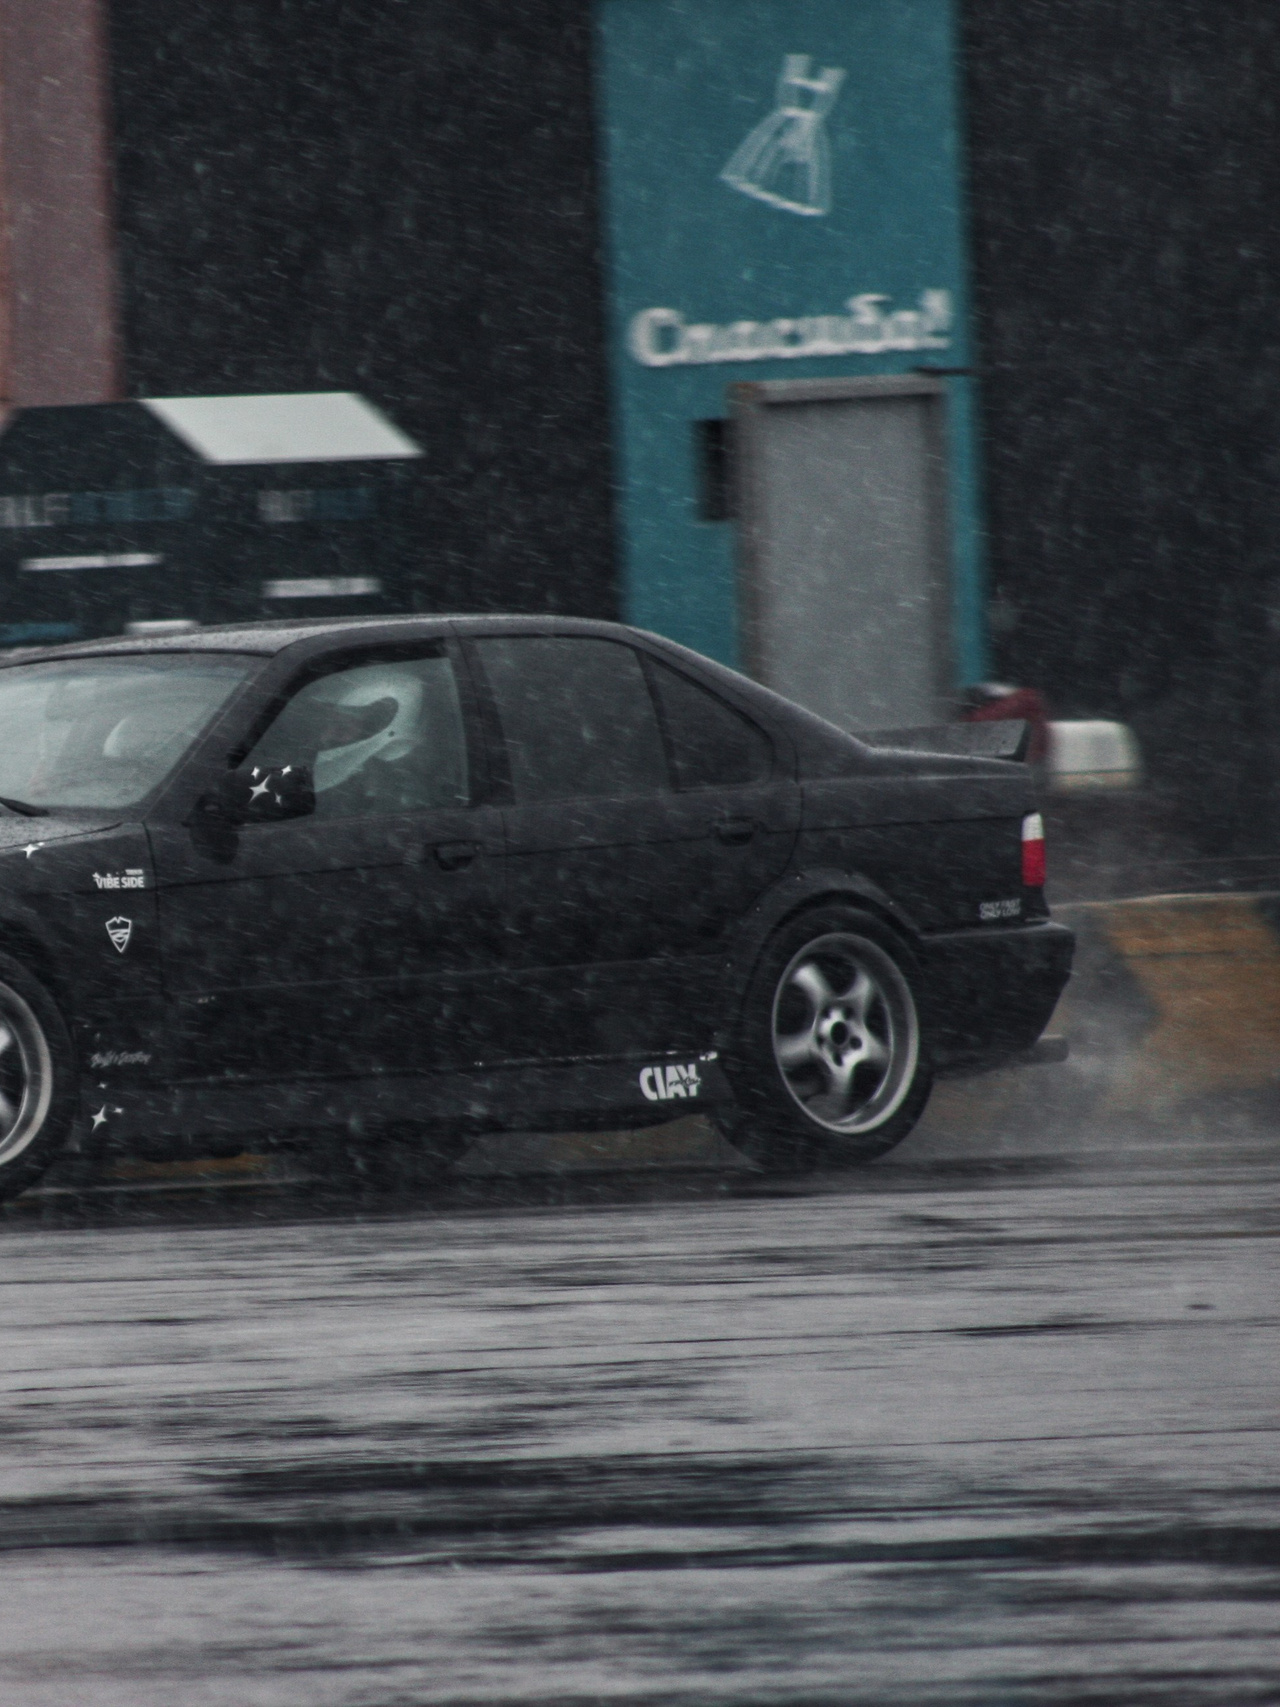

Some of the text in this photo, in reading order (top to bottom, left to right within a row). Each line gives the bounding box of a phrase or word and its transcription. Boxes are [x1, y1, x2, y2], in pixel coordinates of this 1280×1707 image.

[94, 876, 145, 889] VIBE SIDE
[639, 1063, 698, 1101] CLAY
